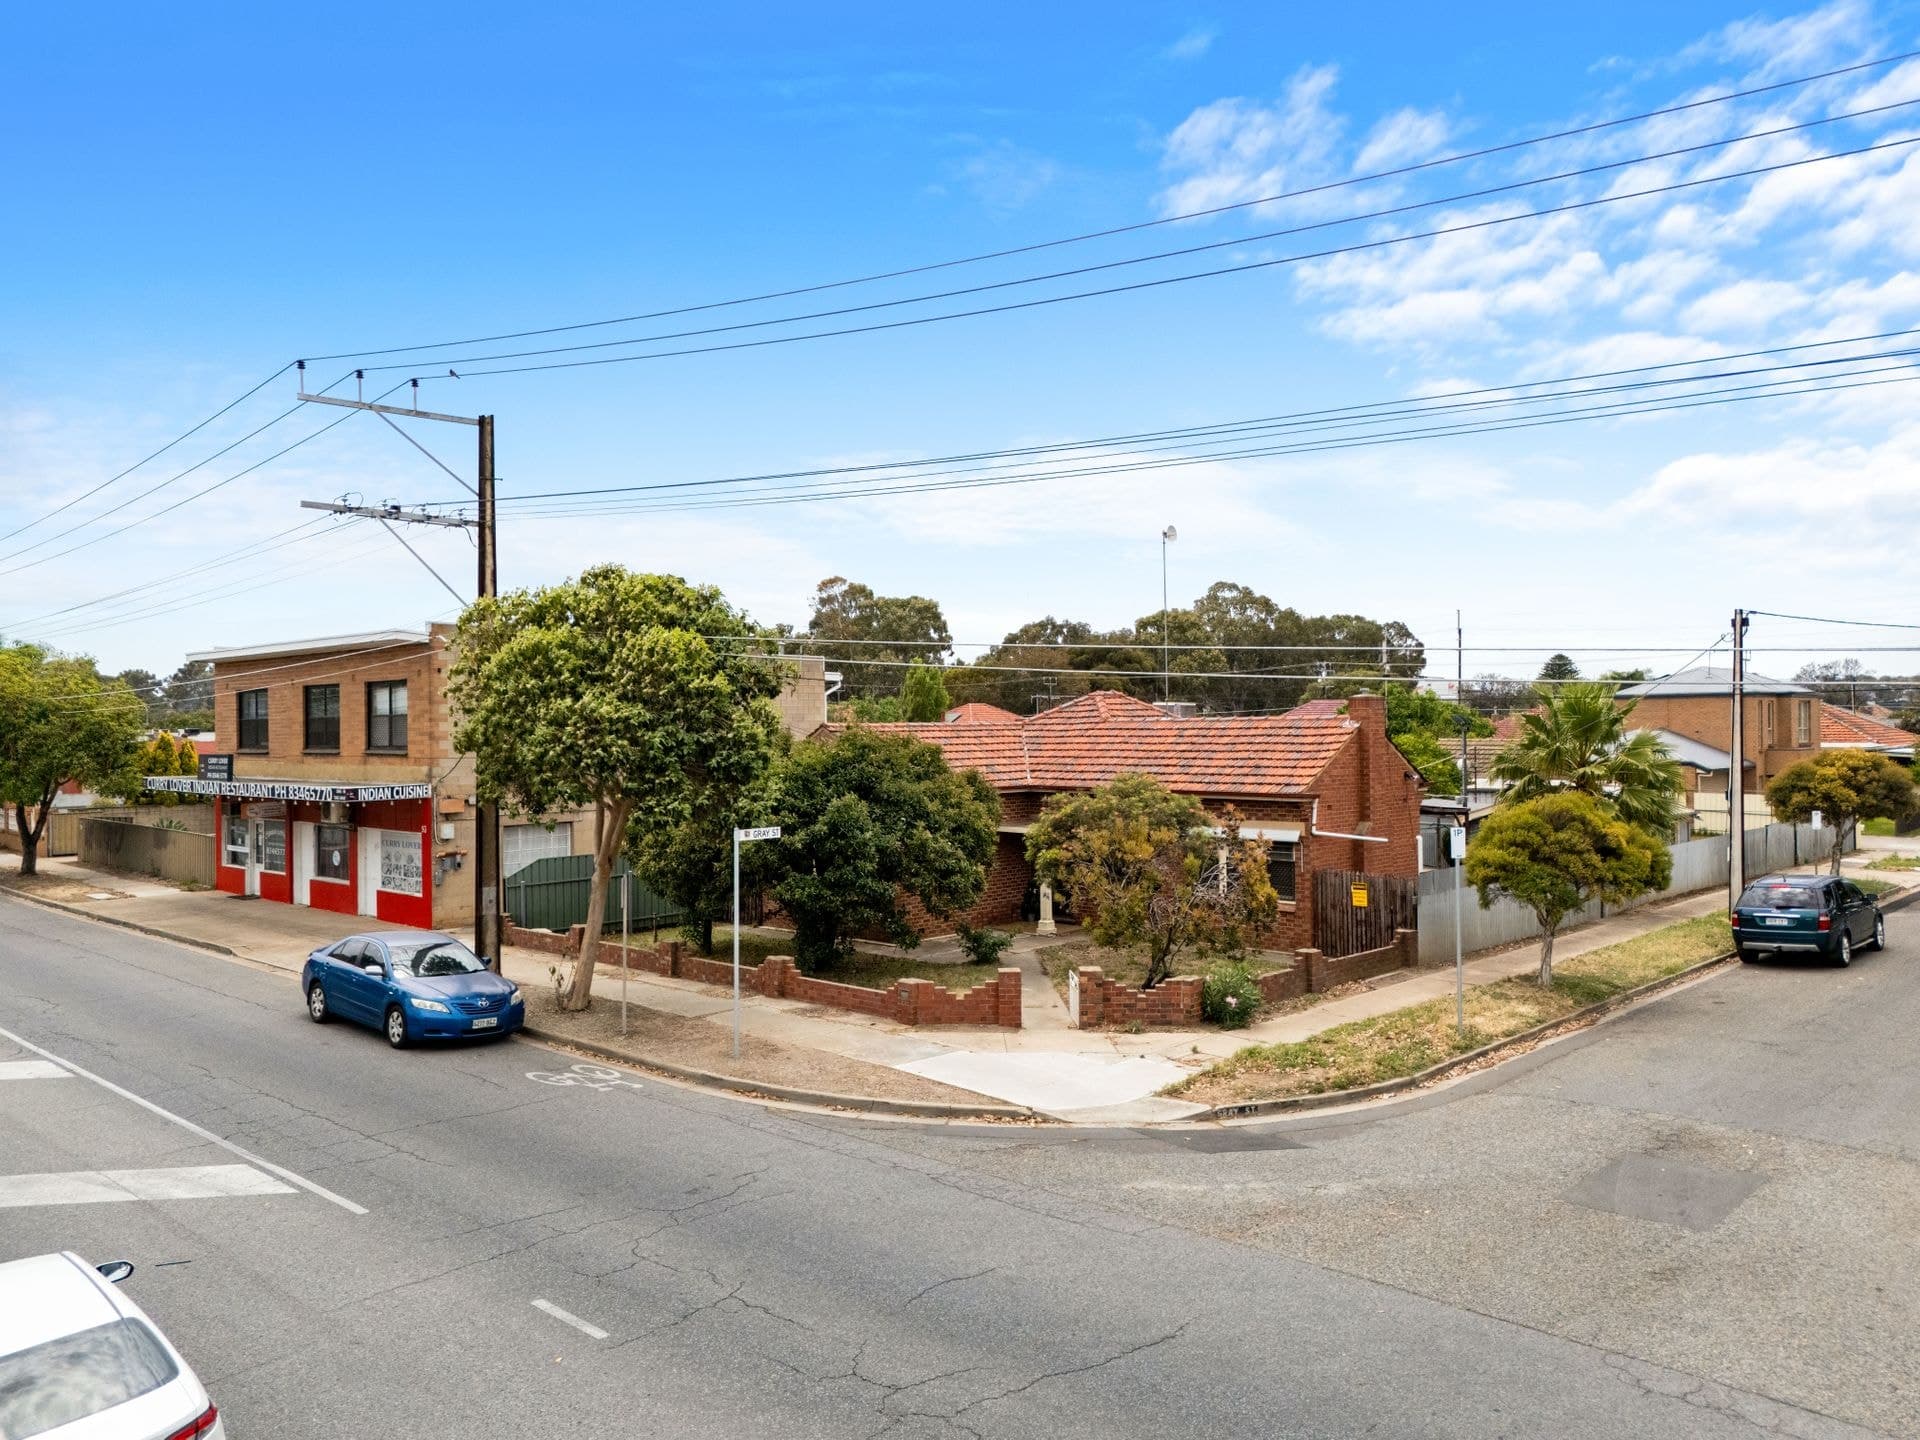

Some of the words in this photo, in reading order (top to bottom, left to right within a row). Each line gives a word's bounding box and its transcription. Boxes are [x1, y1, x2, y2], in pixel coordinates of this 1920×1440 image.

[147, 779, 168, 790] CURRY
[169, 780, 192, 792] LOVER
[193, 780, 220, 794] INDIAN
[221, 782, 275, 798] RESTAURANT
[275, 785, 286, 798] PH
[288, 785, 333, 801] 83465770
[358, 786, 392, 800] INDIAN
[393, 784, 429, 799] CUISINE
[753, 829, 769, 838] GRAY
[771, 828, 779, 836] ST
[381, 839, 400, 848] CURRY
